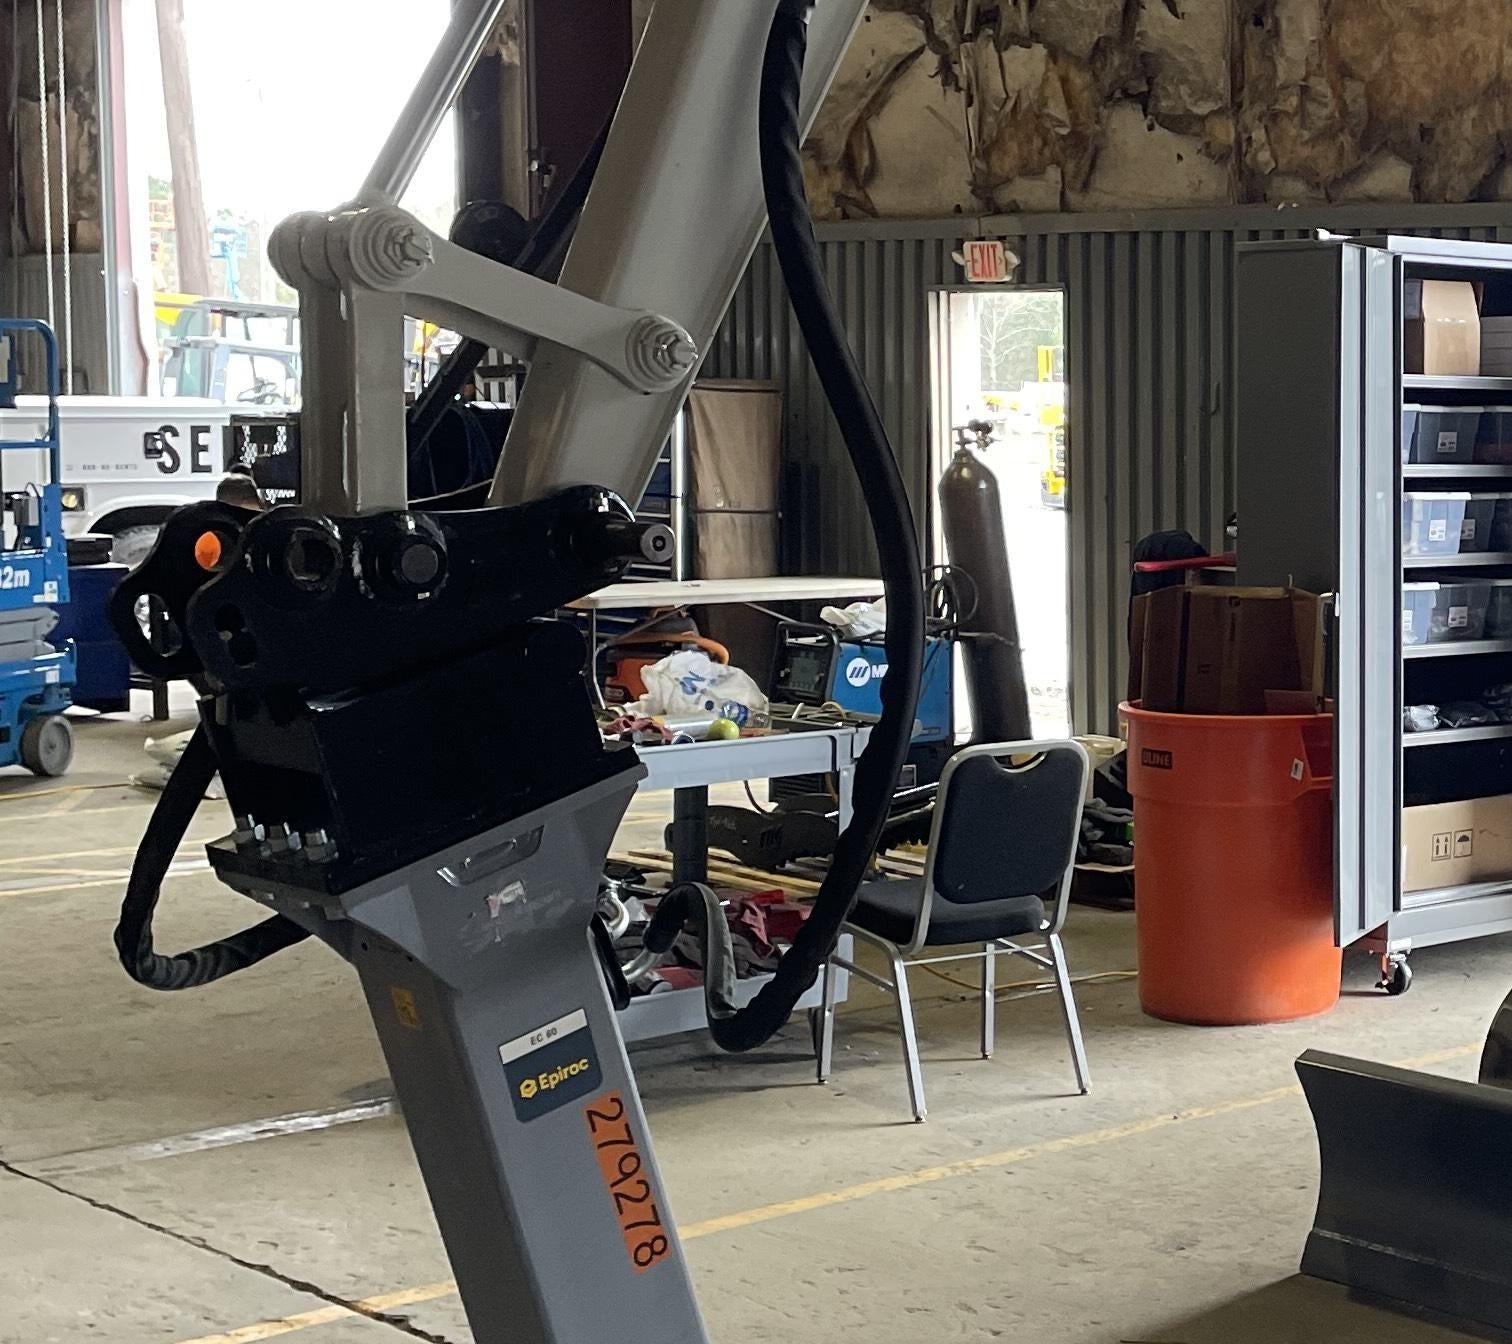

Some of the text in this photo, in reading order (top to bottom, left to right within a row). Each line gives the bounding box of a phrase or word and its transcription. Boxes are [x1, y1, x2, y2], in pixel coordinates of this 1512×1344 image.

[969, 243, 998, 278] EXIT
[0, 565, 30, 590] 2m
[529, 1027, 558, 1046] EC 60
[538, 1058, 589, 1090] Epiroc
[586, 1096, 669, 1269] 279278
